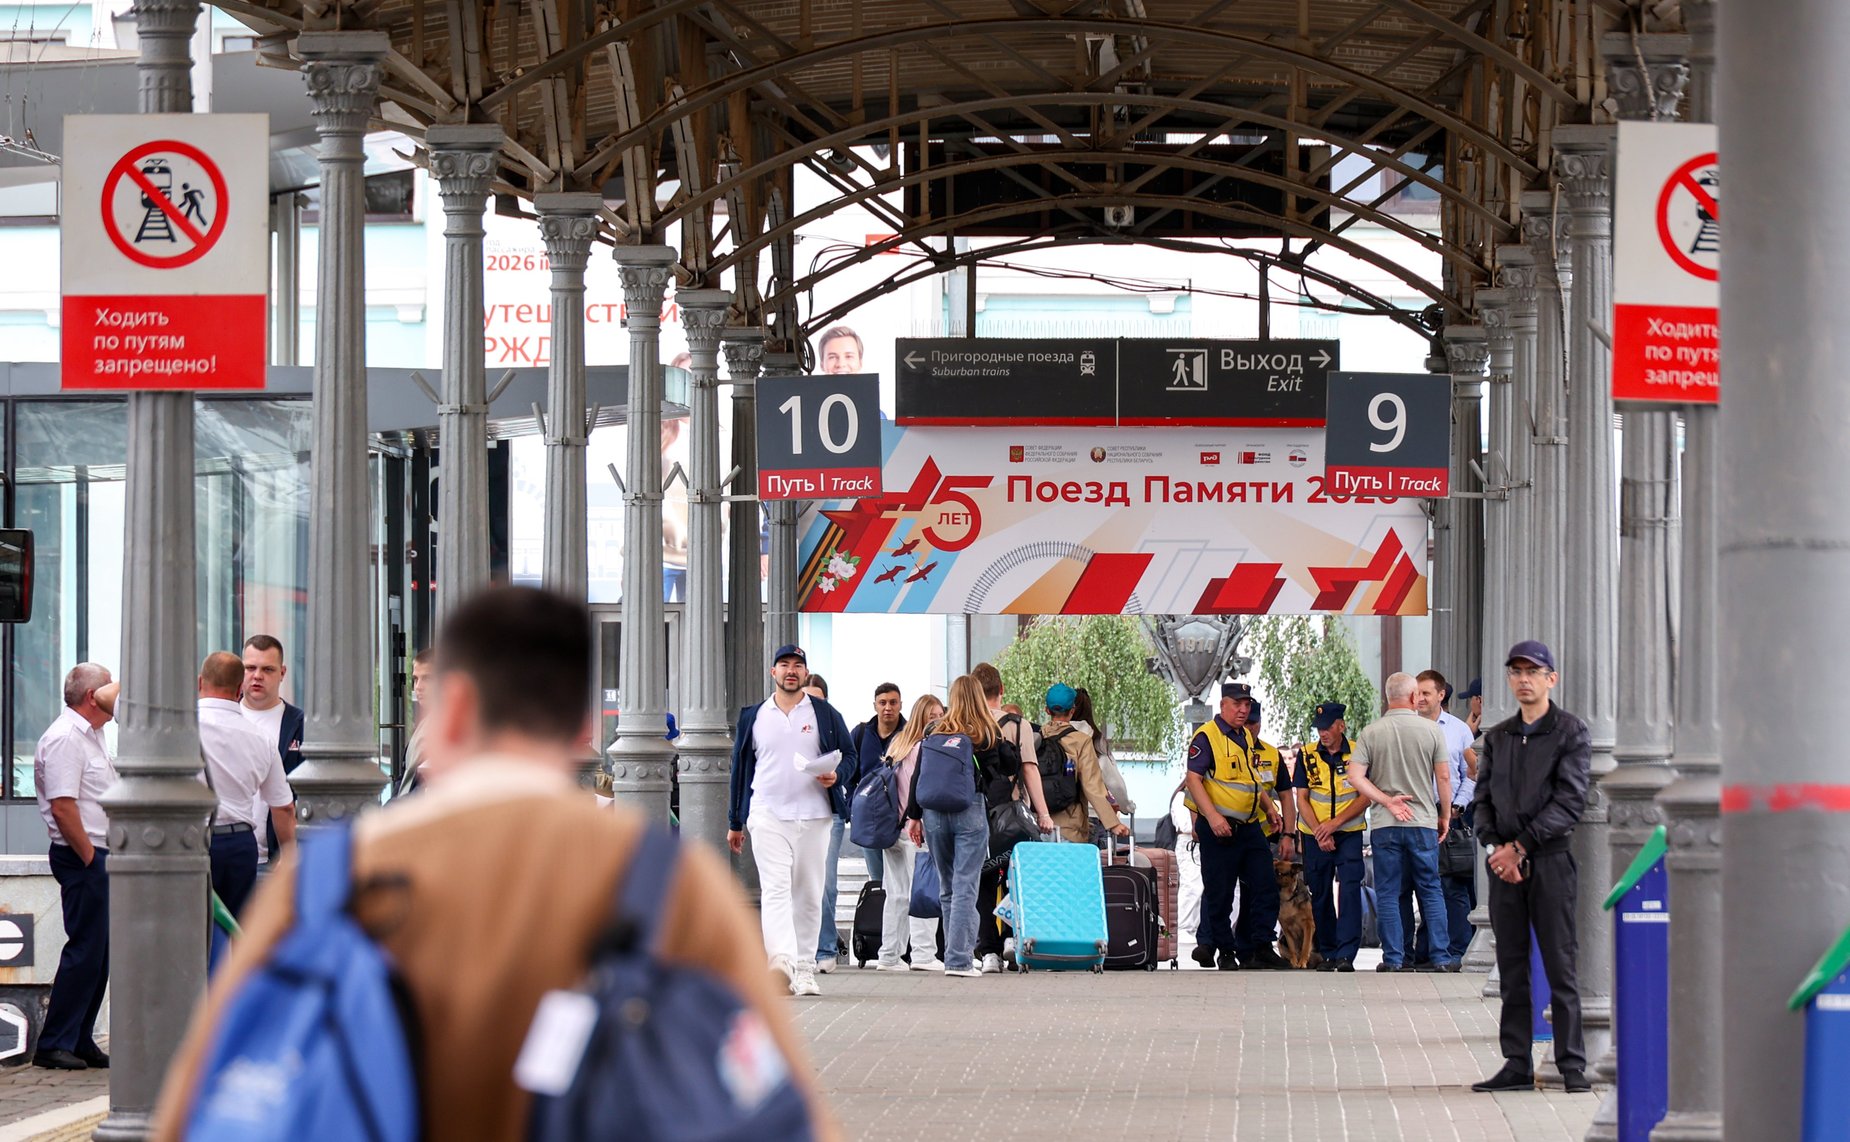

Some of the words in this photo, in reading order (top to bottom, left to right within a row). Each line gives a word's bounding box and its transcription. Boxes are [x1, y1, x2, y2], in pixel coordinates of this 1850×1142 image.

[486, 255, 535, 271] 2026
[95, 308, 170, 330] Ходить
[93, 335, 120, 350] по
[124, 335, 185, 355] путям
[1645, 345, 1673, 361] по
[1676, 346, 1721, 367] путя
[93, 354, 217, 378] запрещено!
[931, 350, 1025, 364] Пригородные
[1027, 351, 1074, 363] поезда
[1220, 349, 1303, 374] Выход
[931, 366, 980, 377] Suburban
[982, 367, 1011, 377] trains
[1267, 375, 1304, 392] Exit
[778, 393, 859, 455] 10
[1367, 392, 1407, 453] 9
[767, 475, 815, 497] Путь
[831, 475, 873, 491] Track
[1007, 475, 1131, 507] Поезд
[1144, 475, 1293, 503] Памяти
[1335, 471, 1383, 494] Путь
[1399, 476, 1442, 491] Track
[938, 512, 971, 525] ЛЕТ
